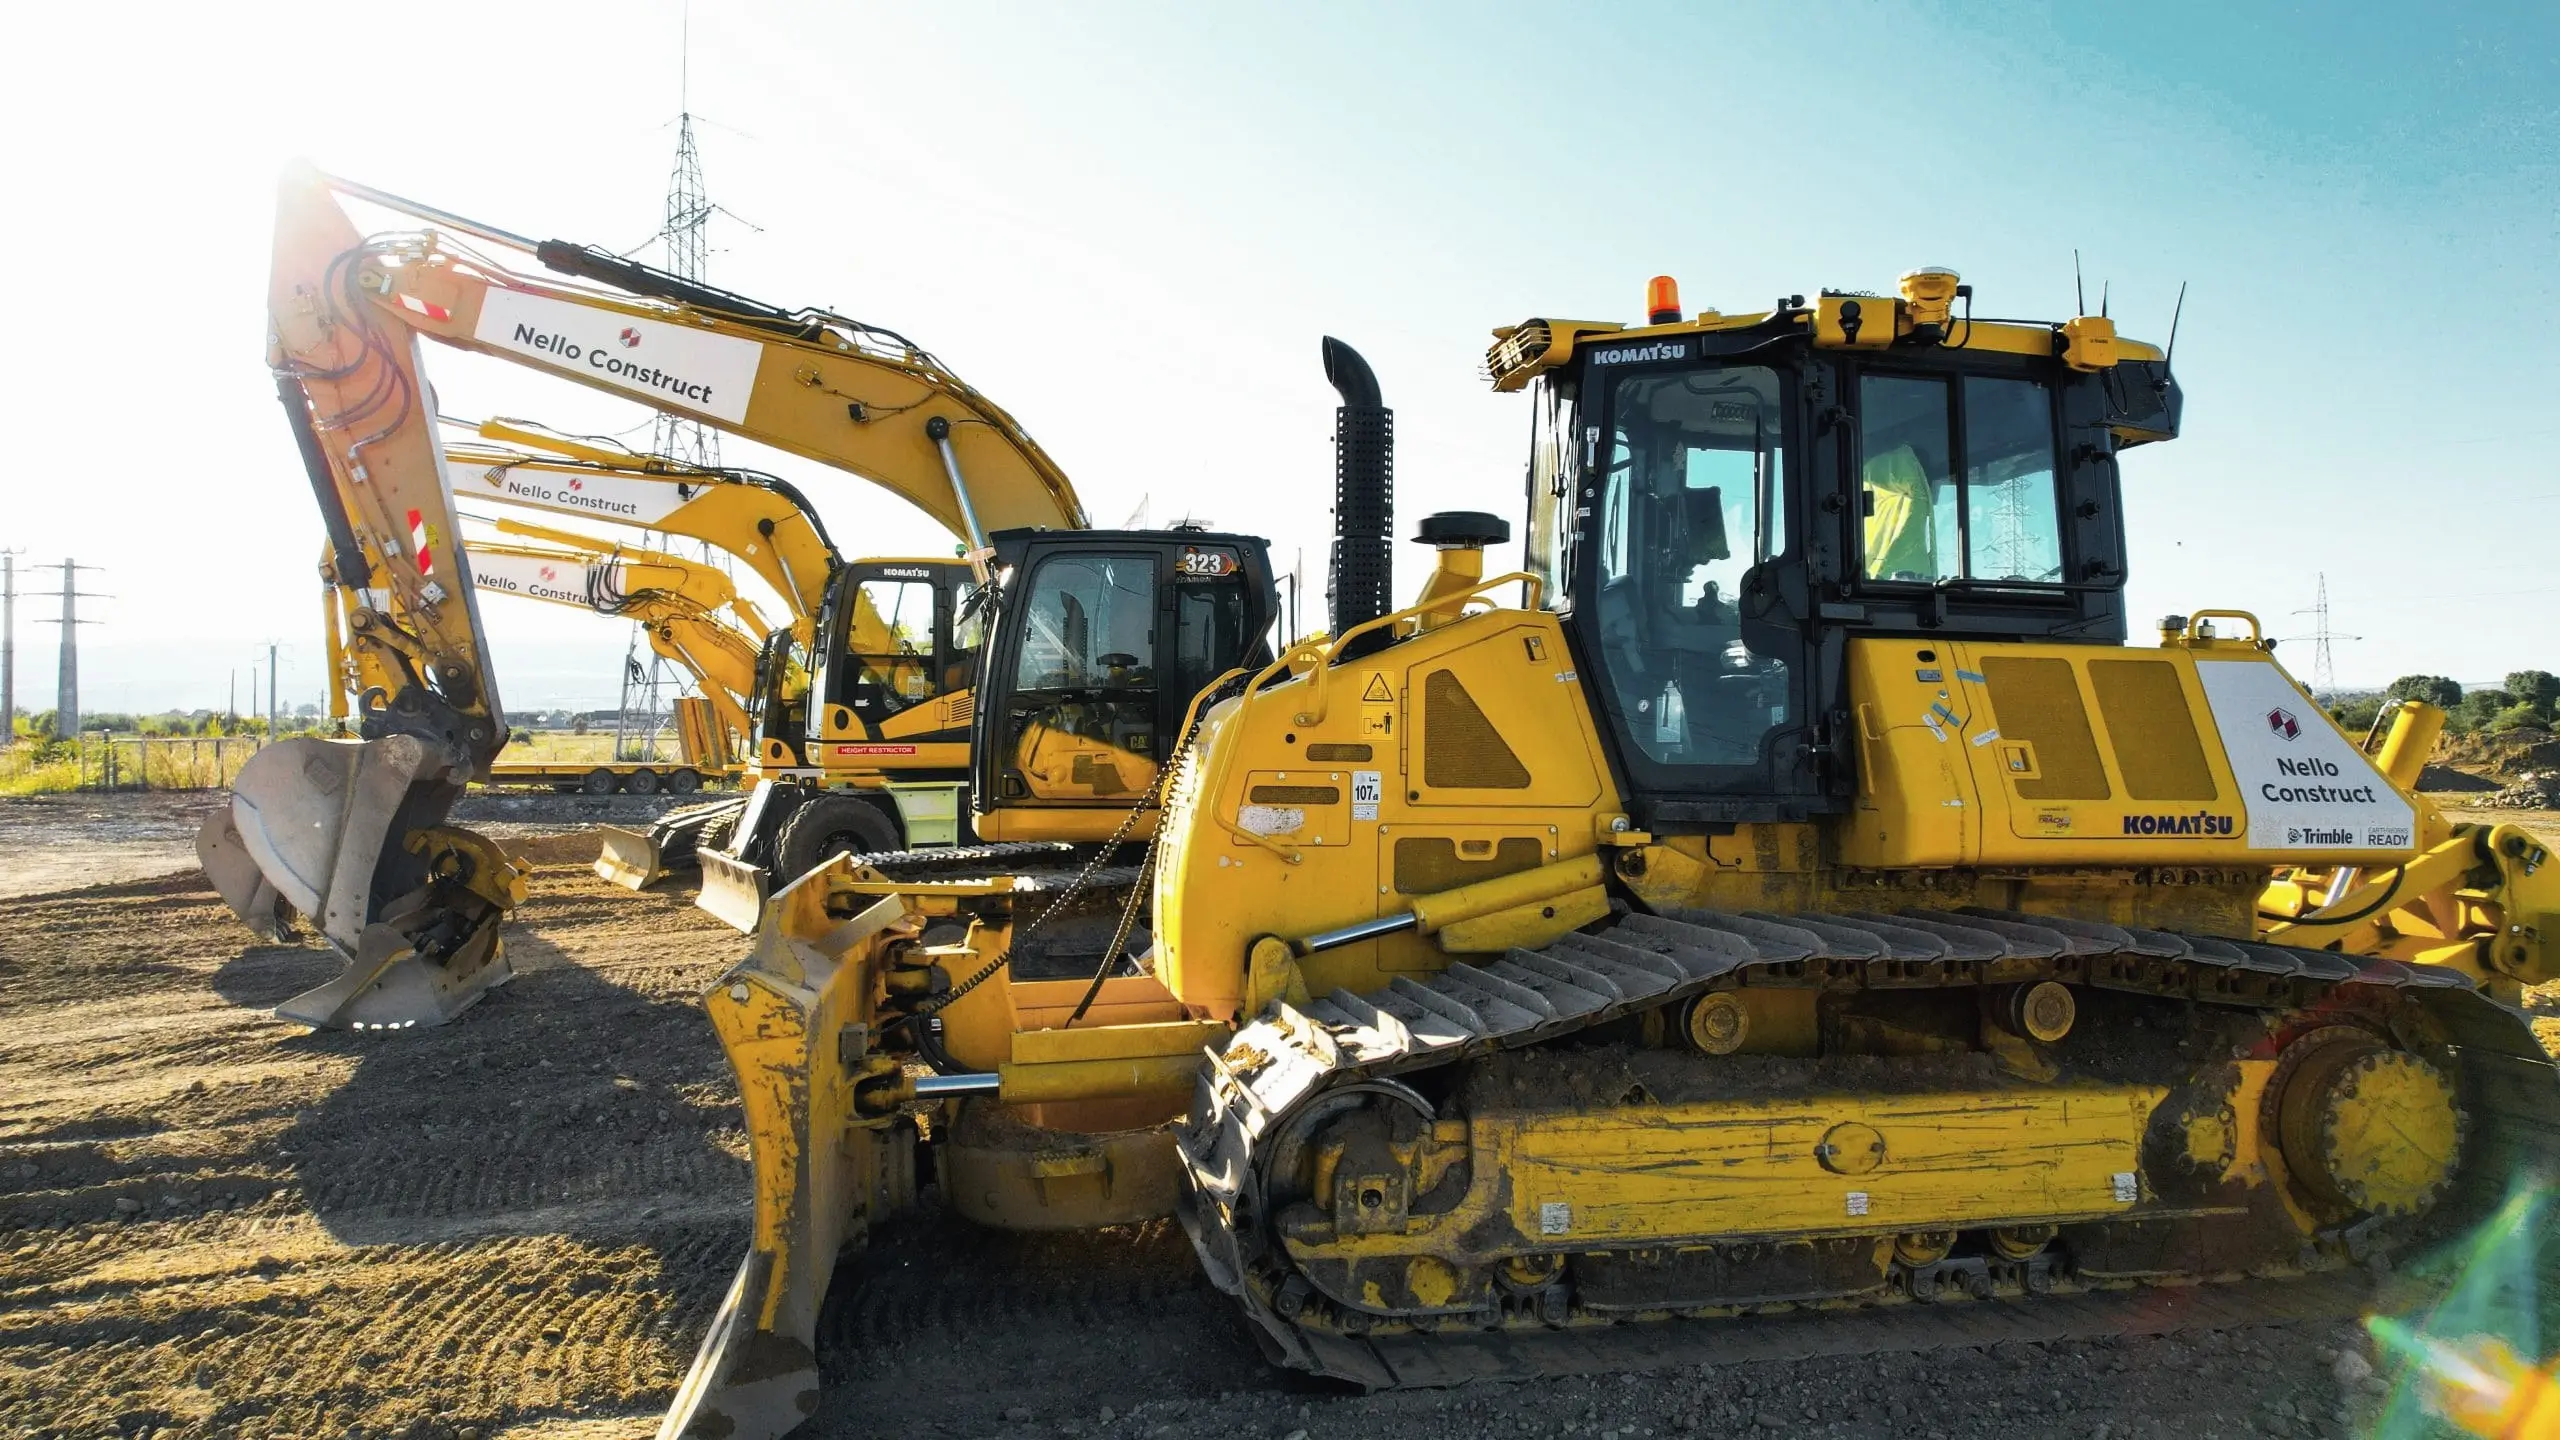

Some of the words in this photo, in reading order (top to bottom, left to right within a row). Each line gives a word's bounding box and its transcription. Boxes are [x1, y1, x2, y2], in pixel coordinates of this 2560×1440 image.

[514, 323, 581, 360] Nello
[589, 349, 713, 404] Construct
[1594, 342, 1685, 365] KOMATSU
[508, 481, 552, 500] Nello
[557, 490, 637, 515] Construct
[883, 567, 930, 578] KOMATSU
[1185, 553, 1221, 574] 323
[477, 573, 517, 591] Nello
[529, 584, 602, 608] Construt
[868, 746, 913, 754] RESTRICTOR
[2277, 757, 2339, 777] Nello
[1355, 785, 1373, 801] 107
[2261, 783, 2377, 804] Construct
[2123, 810, 2233, 835] KOMATSU
[2302, 828, 2353, 845] Trimble
[2368, 834, 2409, 846] READY
